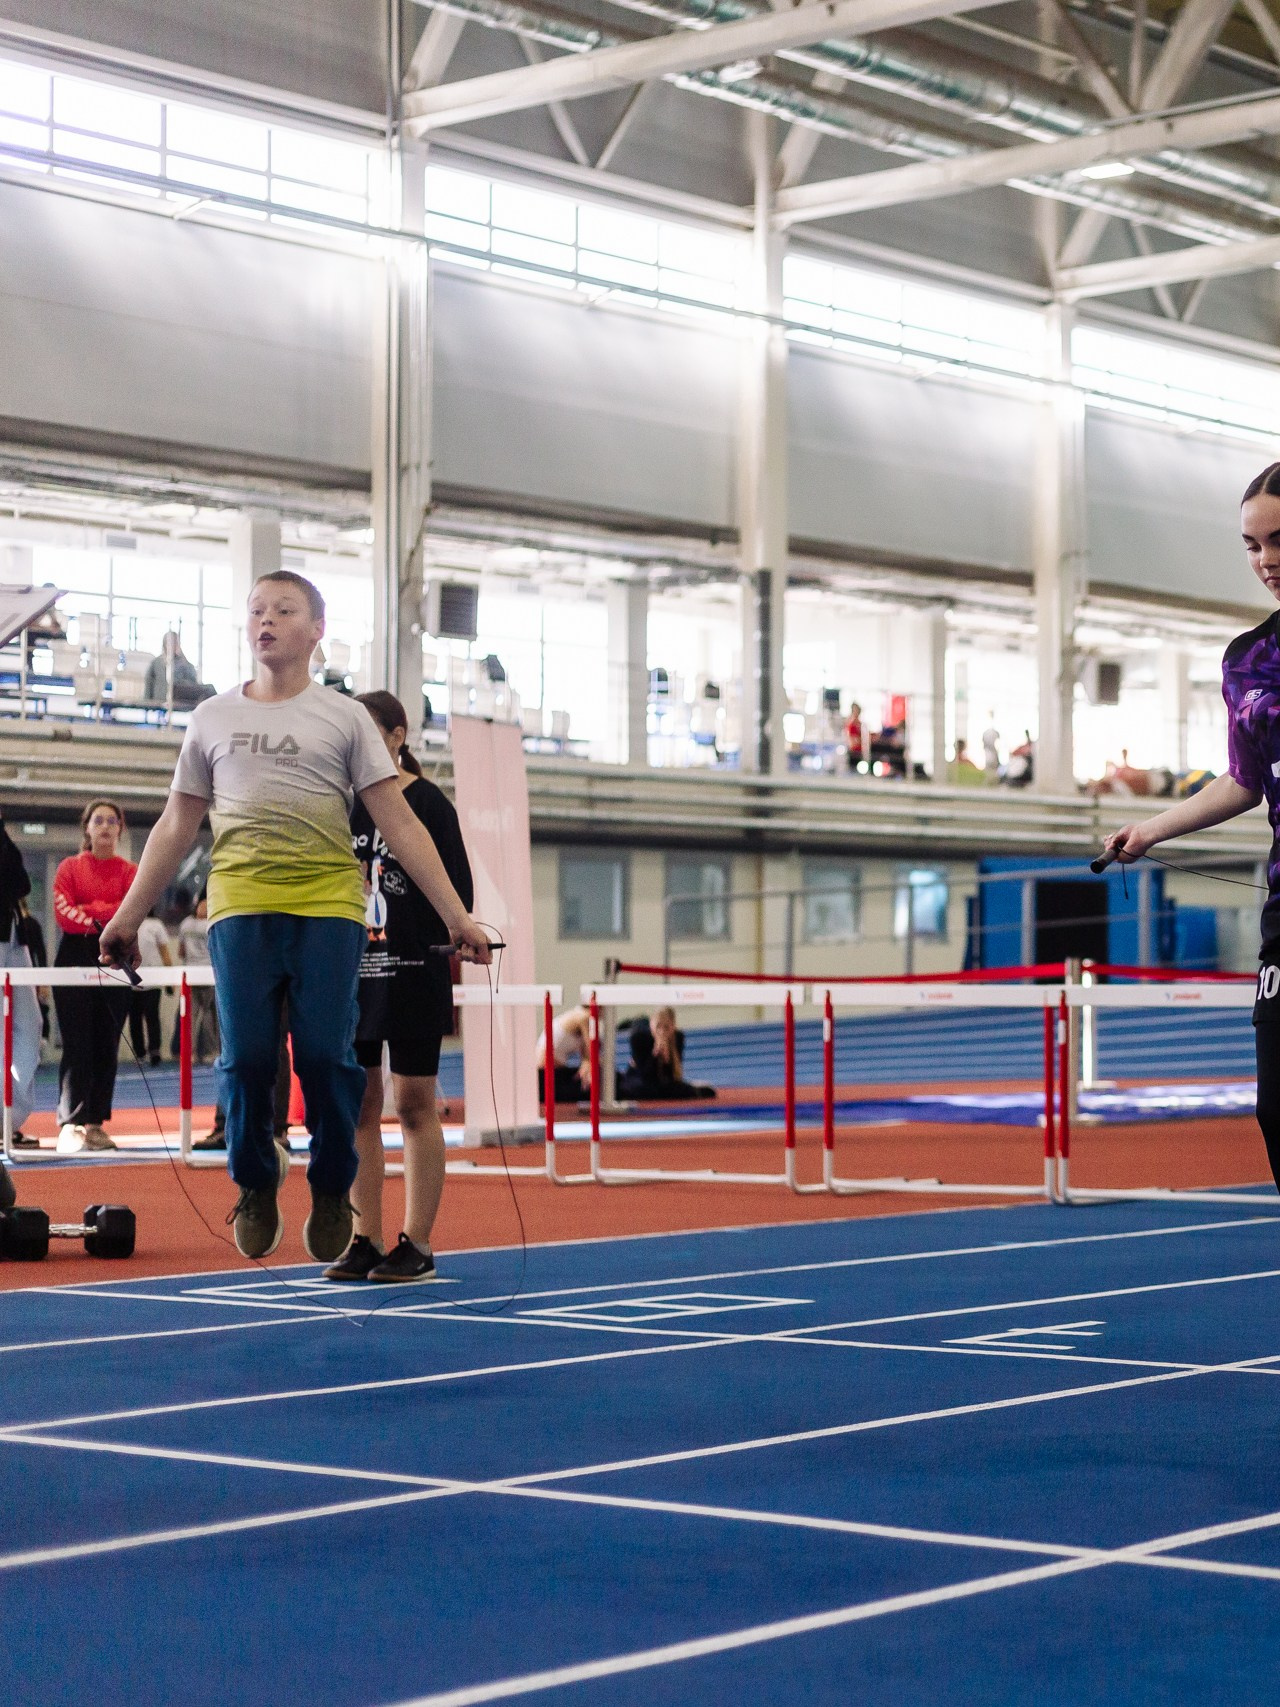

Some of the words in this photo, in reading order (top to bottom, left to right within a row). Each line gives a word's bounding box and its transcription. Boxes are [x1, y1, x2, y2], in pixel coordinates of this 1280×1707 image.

[229, 732, 301, 755] FILA
[275, 758, 298, 768] PRO
[1257, 965, 1280, 1000] 10
